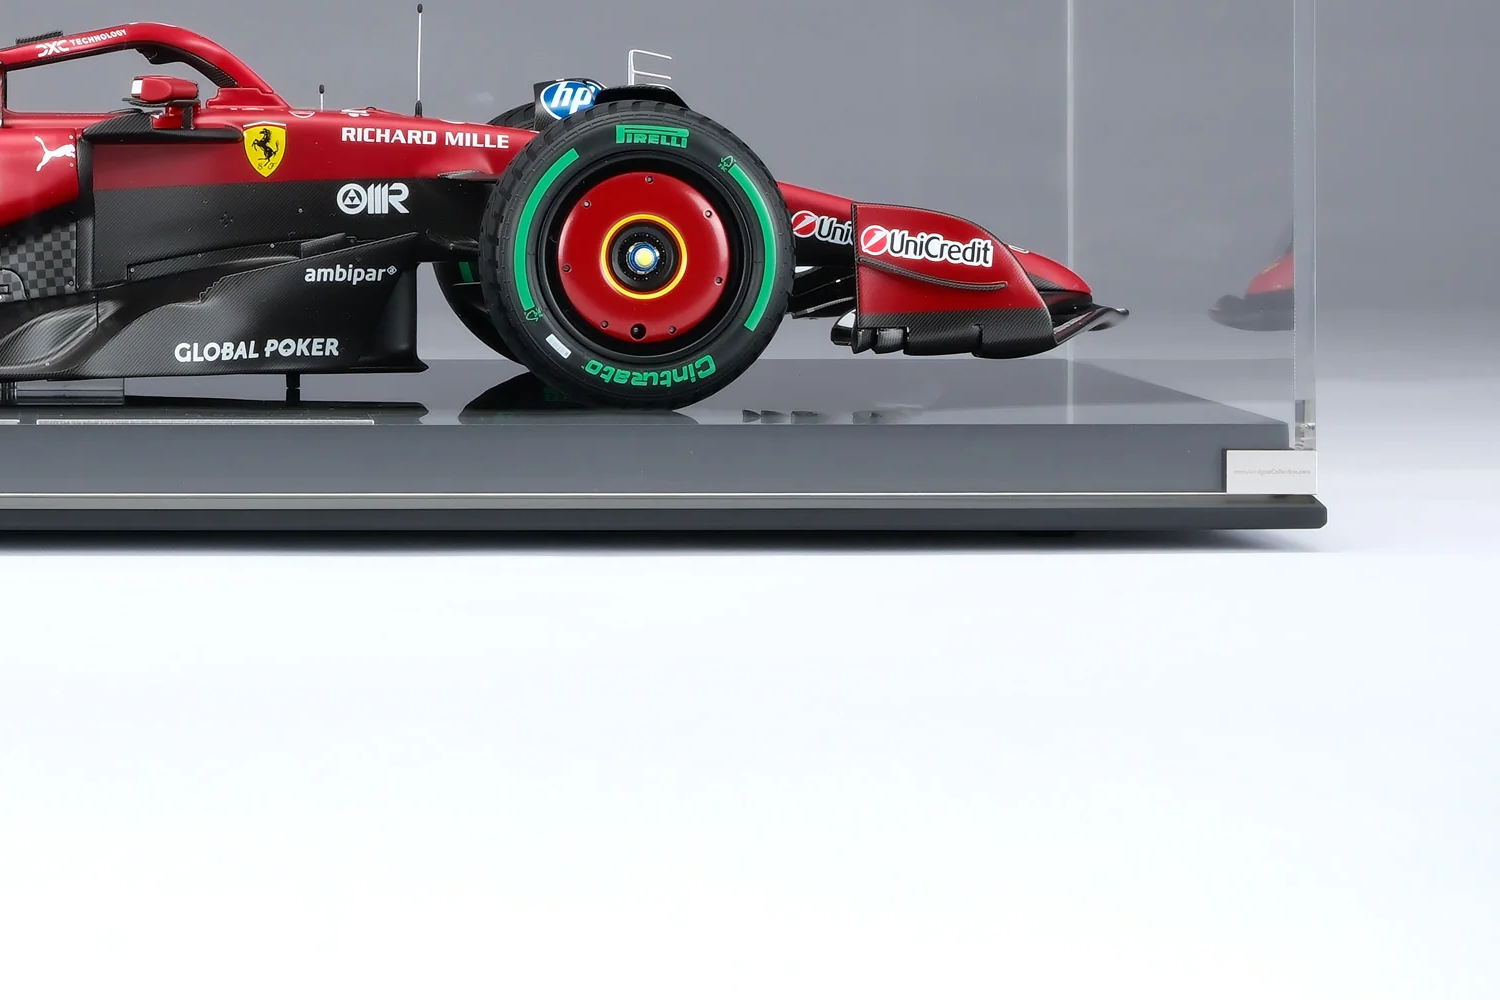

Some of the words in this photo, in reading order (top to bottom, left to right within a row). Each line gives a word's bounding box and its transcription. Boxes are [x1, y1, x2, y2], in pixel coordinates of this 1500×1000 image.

[35, 39, 70, 58] DXC
[69, 29, 127, 47] TECHNOLOGY
[550, 82, 596, 115] hp
[341, 127, 437, 146] RICHARD
[445, 131, 510, 149] MILLE
[615, 124, 690, 149] PIRELLI
[889, 231, 993, 265] UniCredit
[304, 264, 385, 285] ambipar
[174, 341, 259, 362] GLOBAL
[264, 338, 339, 357] POKER
[584, 354, 717, 387] Cinturato
